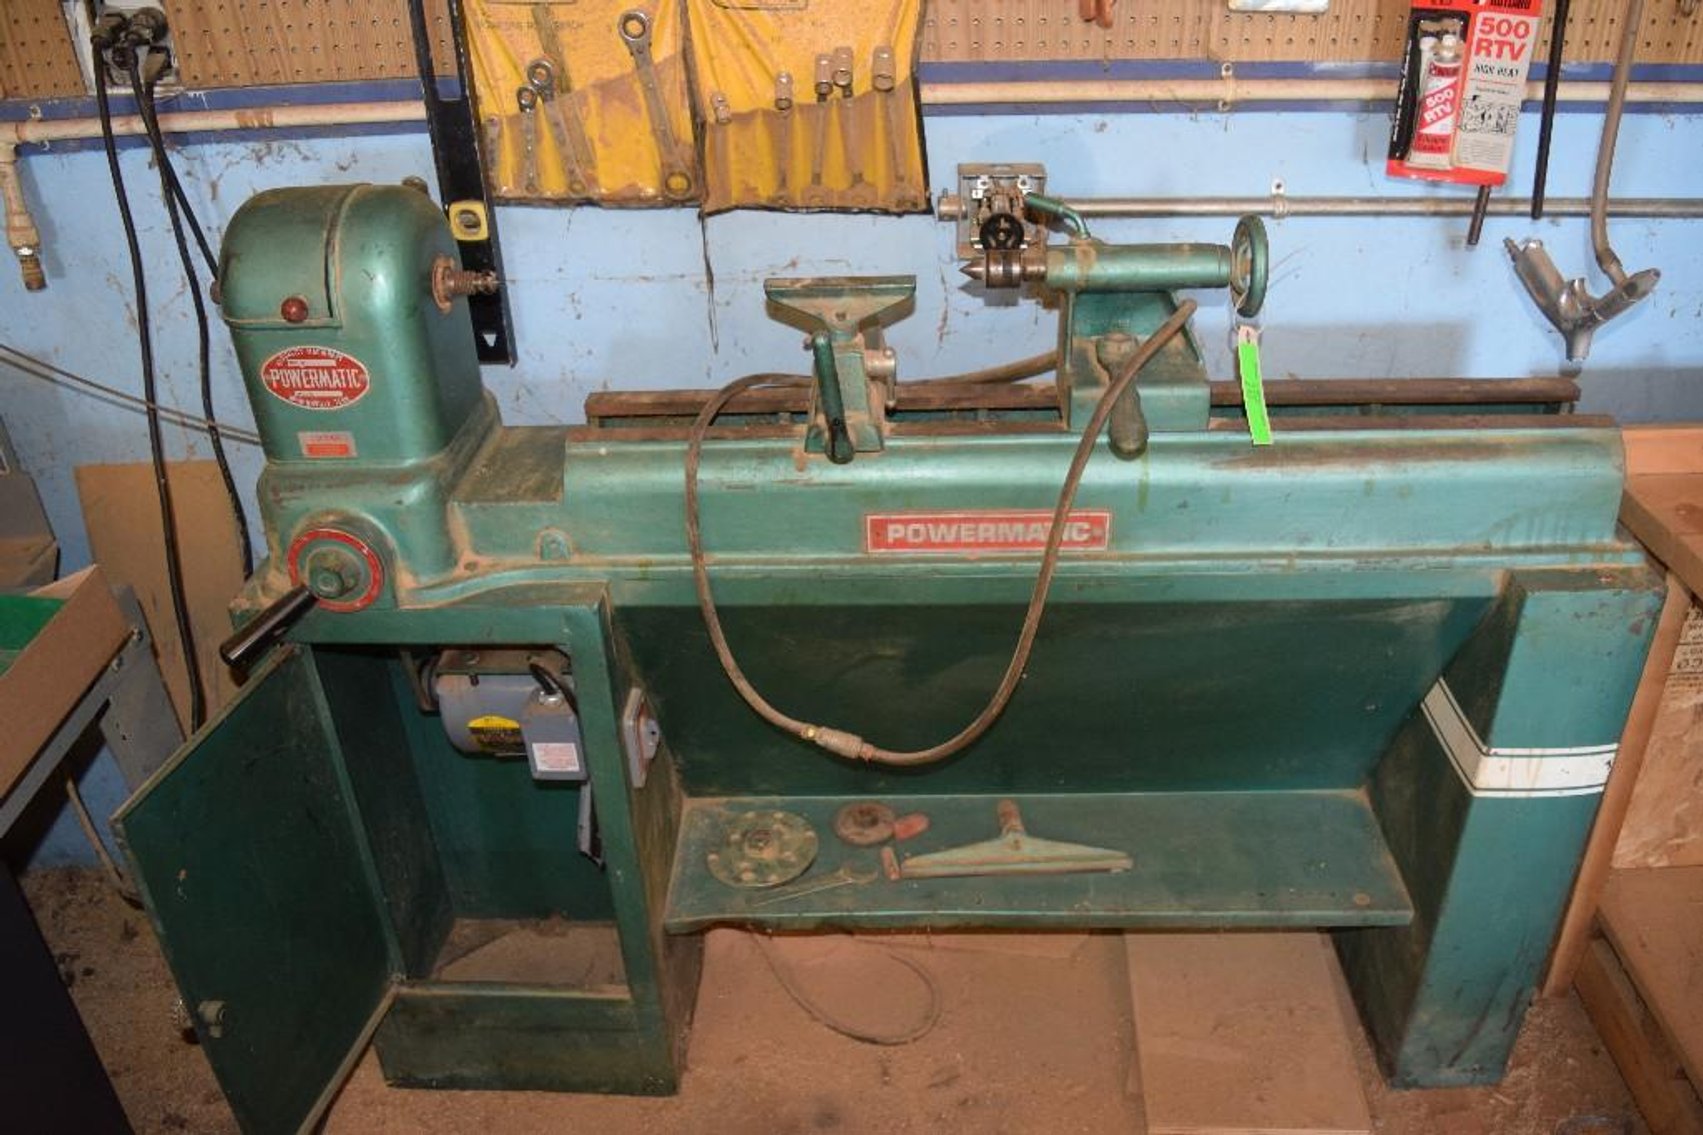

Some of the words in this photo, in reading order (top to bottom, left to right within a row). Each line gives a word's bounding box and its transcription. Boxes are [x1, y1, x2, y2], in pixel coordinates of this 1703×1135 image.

[1479, 17, 1530, 39] 500
[1474, 38, 1527, 61] RTV
[1426, 88, 1454, 108] 500
[1424, 101, 1453, 122] RTV
[270, 368, 361, 390] POWERMATIC
[887, 521, 1092, 543] POWERMAIC
